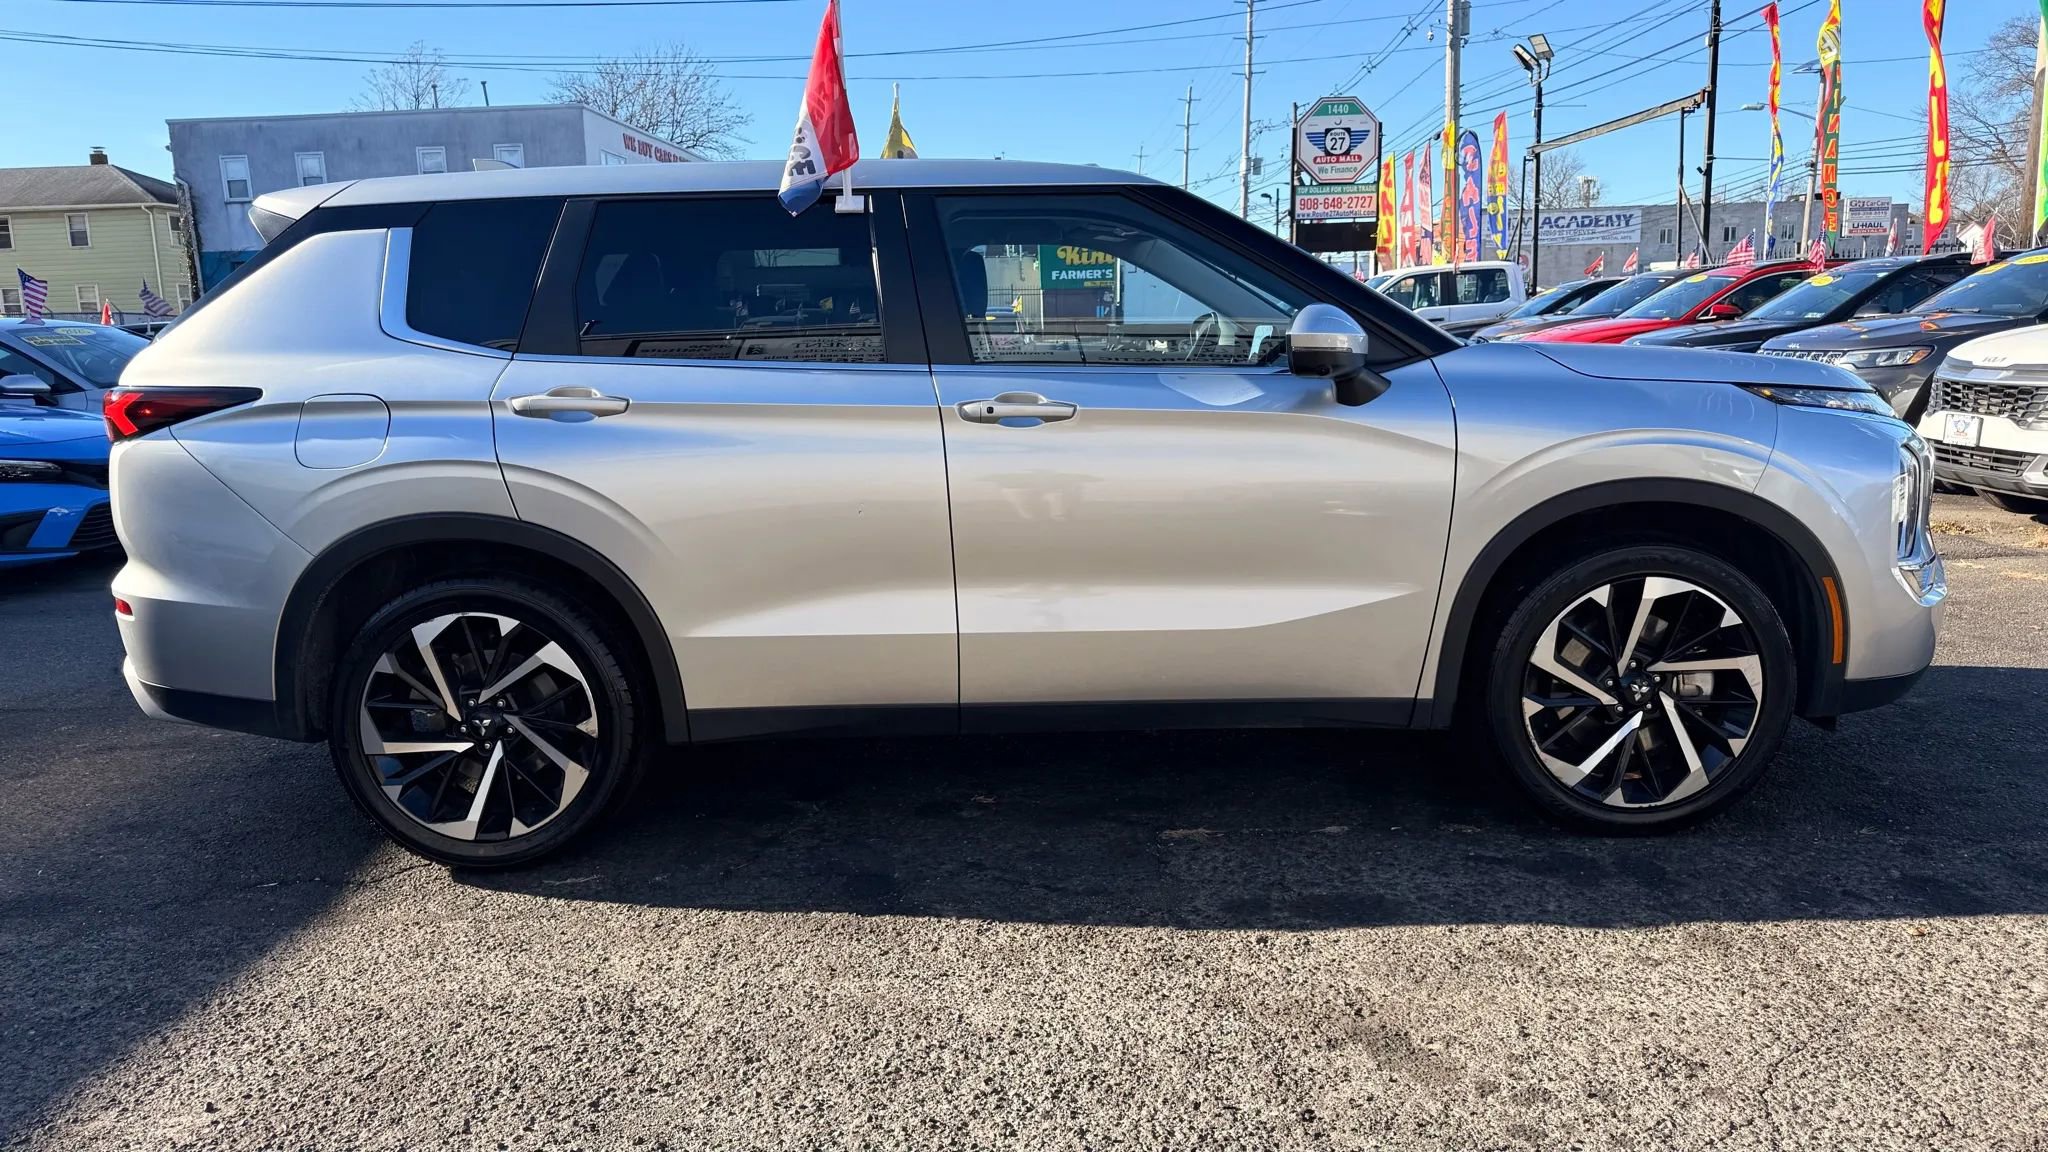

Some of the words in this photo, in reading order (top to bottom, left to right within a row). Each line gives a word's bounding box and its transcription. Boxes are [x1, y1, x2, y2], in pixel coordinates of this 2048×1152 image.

[1328, 104, 1349, 114] 1440
[623, 133, 637, 152] WE
[1330, 137, 1346, 151] 27
[1318, 166, 1329, 174] We
[1330, 166, 1358, 174] Finance
[1300, 196, 1373, 210] 908-648-2727
[1539, 214, 1634, 229] ACADEMY
[1052, 269, 1113, 280] FARMER'S
